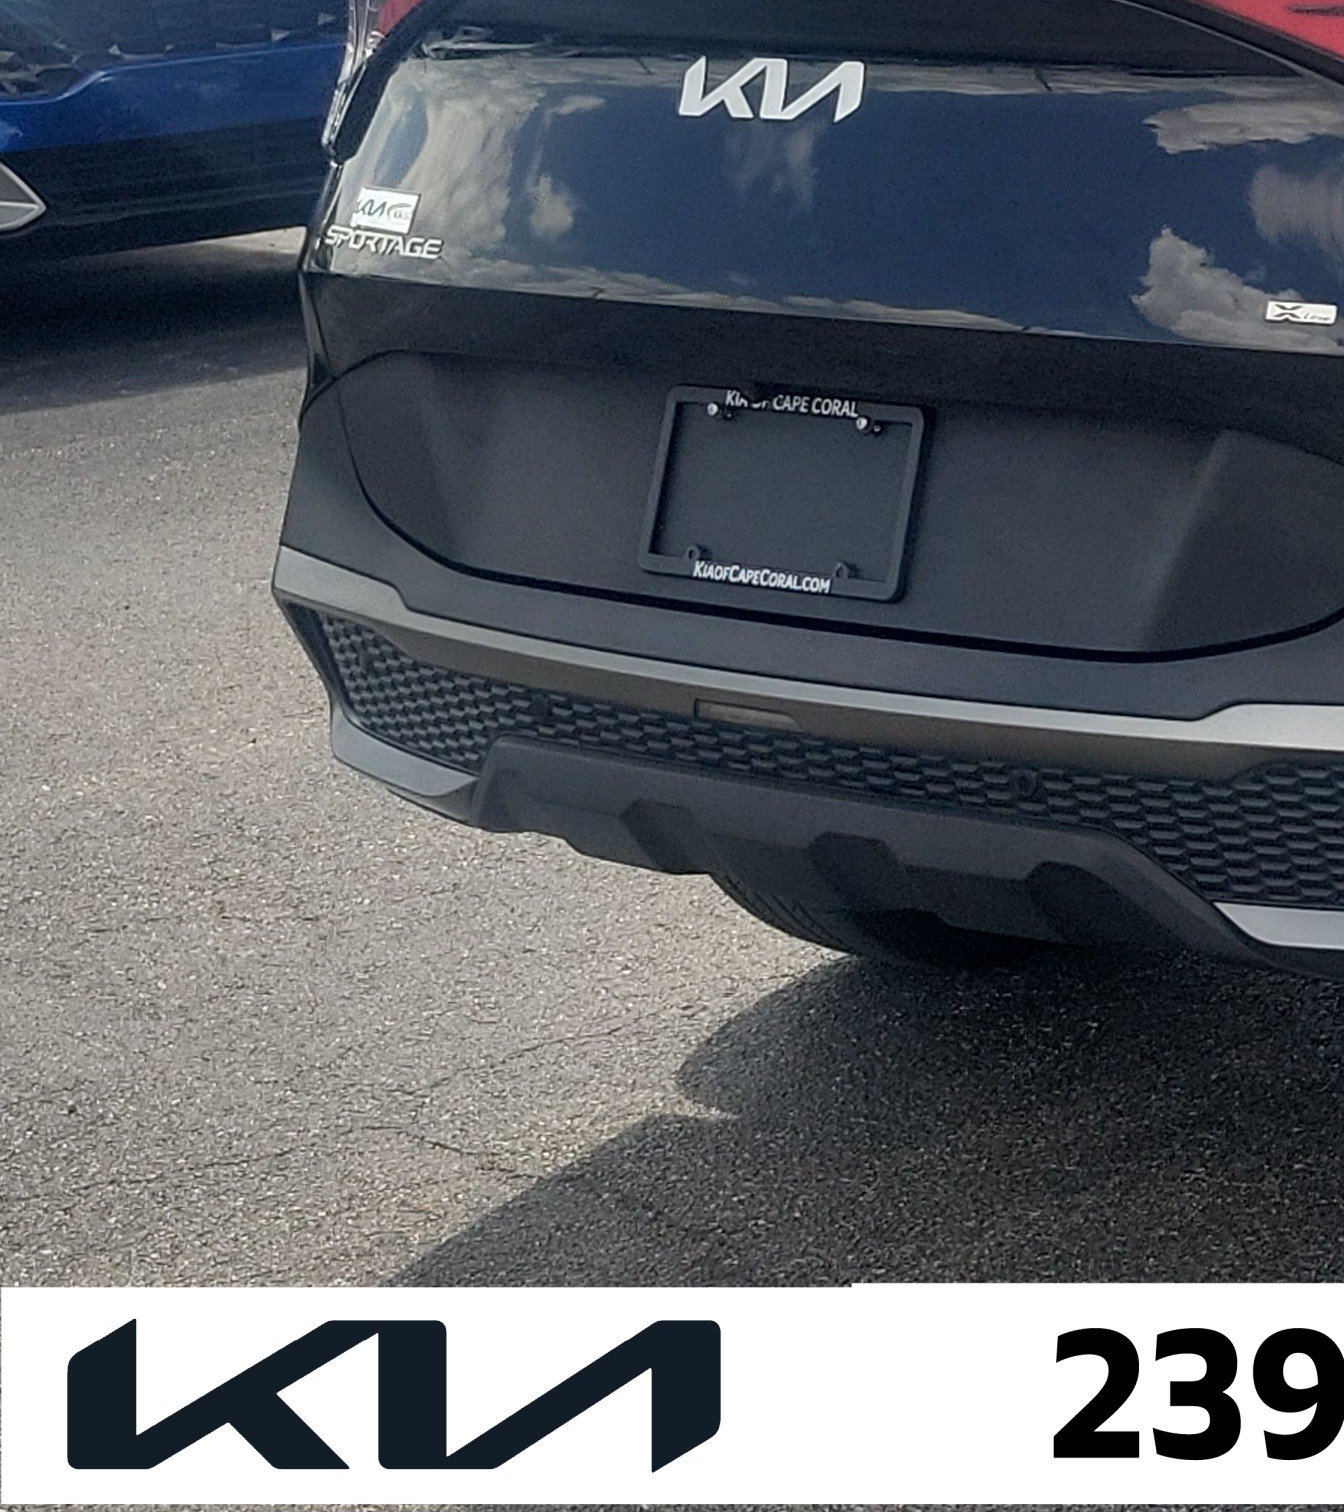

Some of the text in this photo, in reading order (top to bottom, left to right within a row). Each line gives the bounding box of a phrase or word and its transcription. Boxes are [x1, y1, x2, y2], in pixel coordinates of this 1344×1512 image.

[679, 55, 865, 123] KIA
[324, 224, 444, 260] SPORTAGE
[772, 394, 810, 413] CAPE
[811, 397, 859, 418] CORAL
